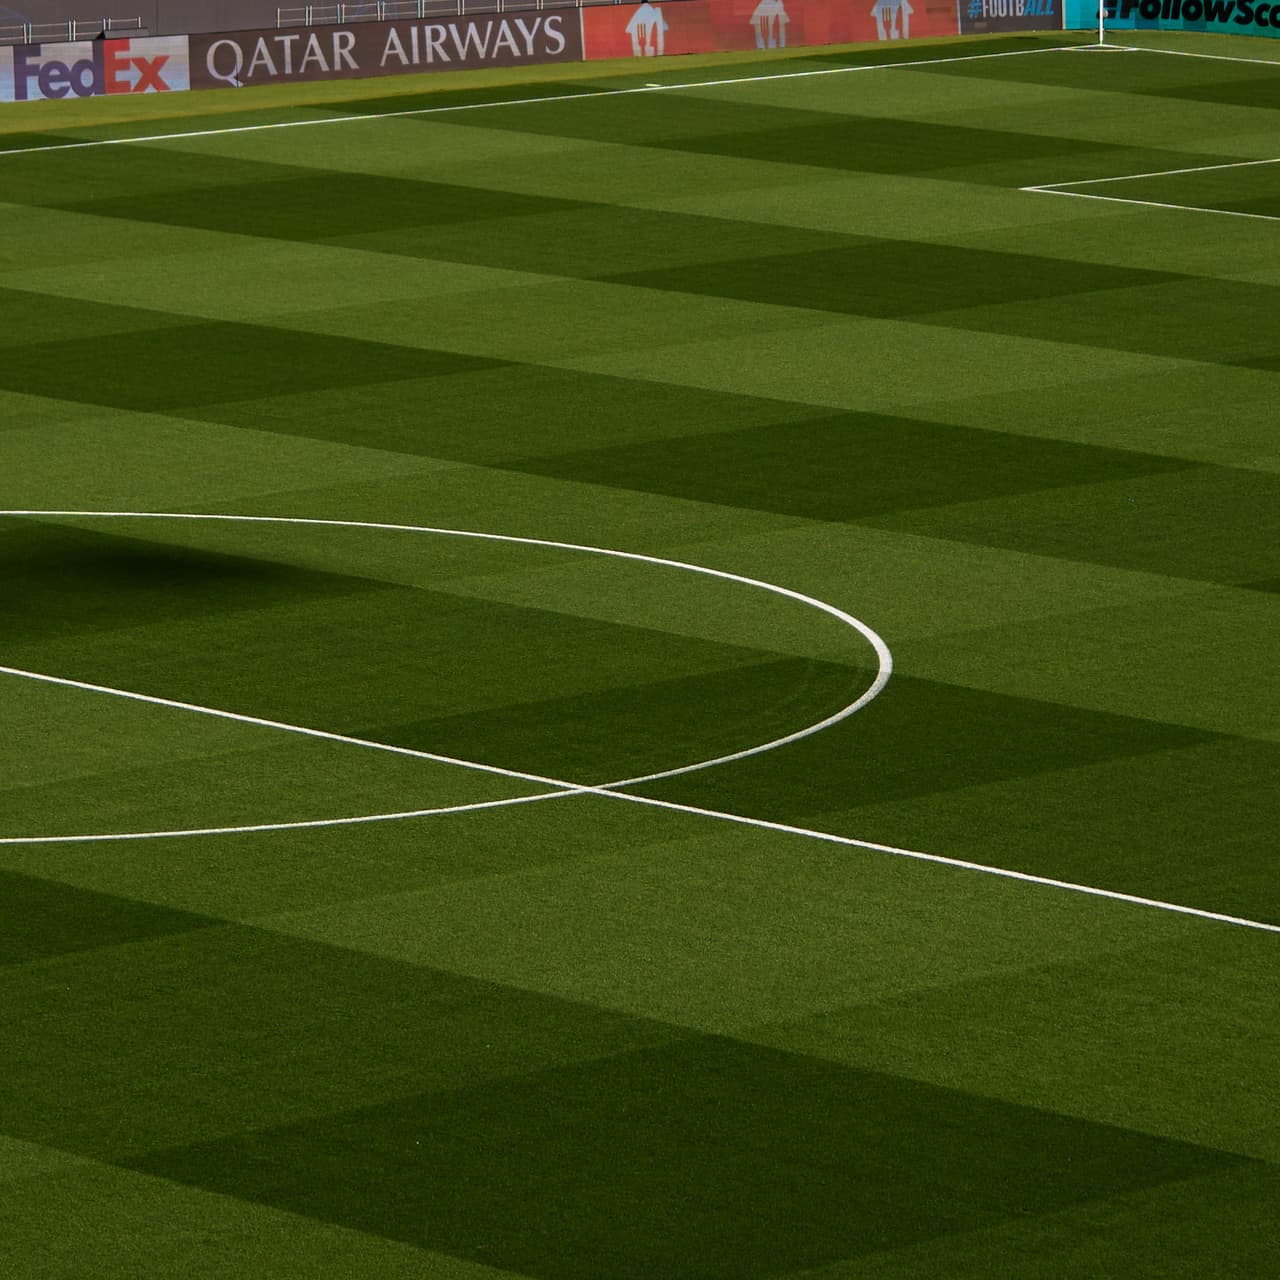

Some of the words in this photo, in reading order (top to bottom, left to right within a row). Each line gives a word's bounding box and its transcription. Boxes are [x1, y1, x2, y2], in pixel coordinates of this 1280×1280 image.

[13, 39, 171, 100] FedEx
[206, 31, 360, 88] QATAR
[380, 15, 566, 67] AIRWAYS
